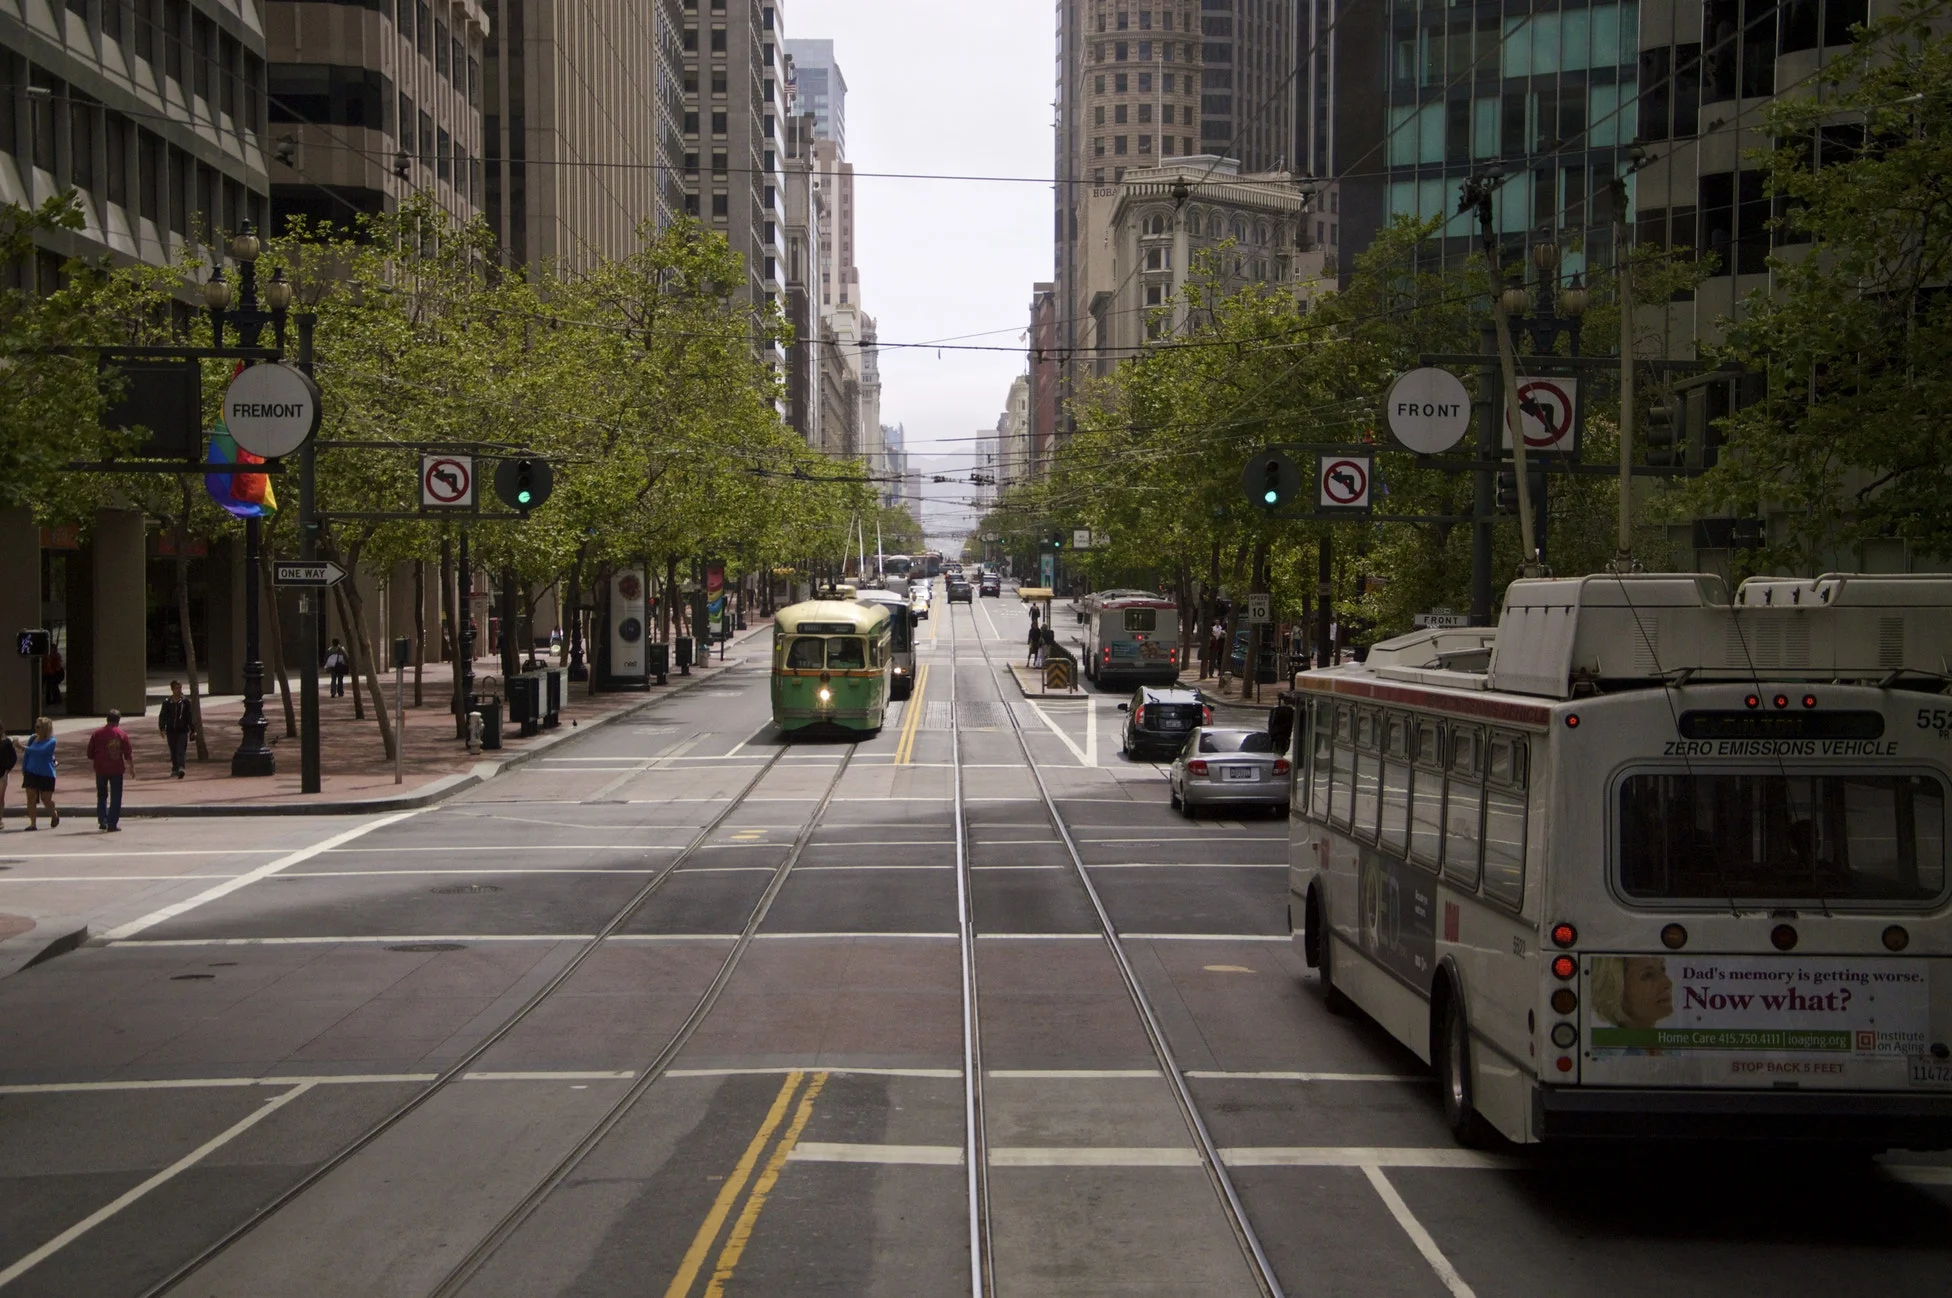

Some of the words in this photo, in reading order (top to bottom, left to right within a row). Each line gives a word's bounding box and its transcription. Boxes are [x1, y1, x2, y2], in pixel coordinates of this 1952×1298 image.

[233, 404, 303, 418] FREMONT
[1398, 403, 1460, 417] FRONT
[281, 569, 301, 578] ONE
[305, 569, 325, 578] WAY
[1253, 607, 1265, 617] 10
[1424, 616, 1458, 624] FRONT
[1917, 709, 1952, 729] 55
[1664, 741, 1712, 755] ZERO
[1718, 741, 1815, 755] EMISSIONS
[1822, 741, 1898, 755] VEHICLE
[1683, 967, 1725, 980] Dad's
[1730, 971, 1794, 984] memory
[1798, 968, 1810, 981] is
[1814, 969, 1869, 985] getting
[1873, 972, 1924, 982] worse.
[1683, 986, 1754, 1010] Now
[1760, 986, 1851, 1011] what?
[1658, 1032, 1689, 1044] Home
[1692, 1032, 1716, 1044] Care
[1719, 1032, 1780, 1045] 415.750.4111
[1788, 1033, 1846, 1048] ioaging.org
[1877, 1031, 1924, 1041] Institute
[1878, 1043, 1892, 1051] on
[1894, 1042, 1925, 1054] Aging
[1732, 1062, 1763, 1072] STOP
[1767, 1062, 1801, 1073] BACK
[1804, 1063, 1810, 1073] 5
[1814, 1063, 1844, 1073] FEET
[1914, 1065, 1952, 1081] 11472
